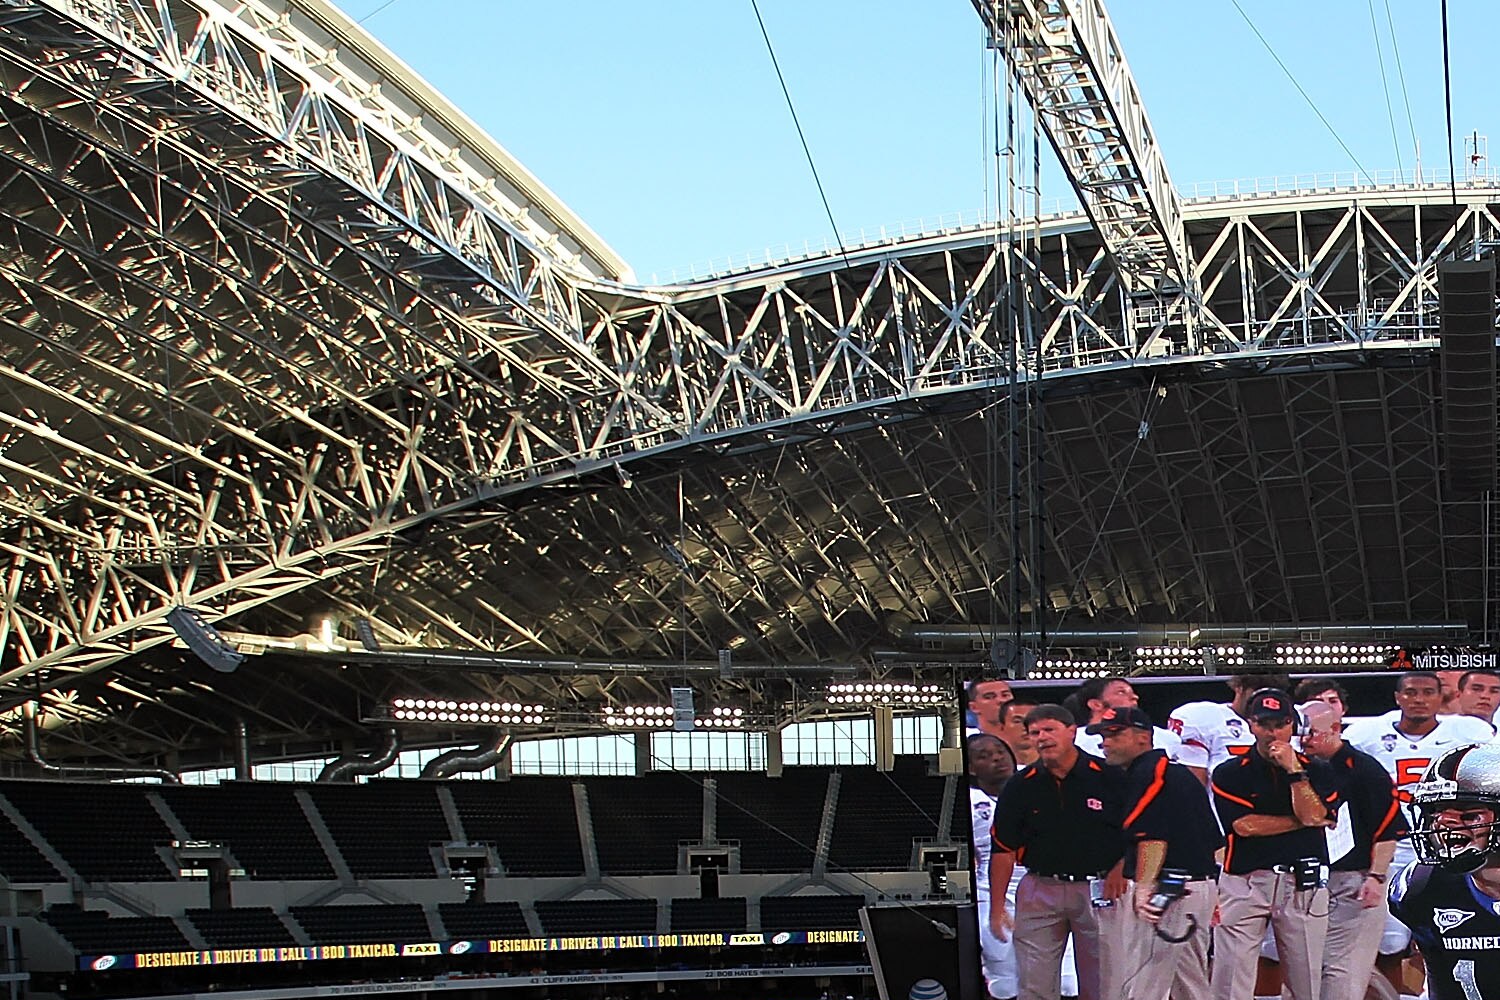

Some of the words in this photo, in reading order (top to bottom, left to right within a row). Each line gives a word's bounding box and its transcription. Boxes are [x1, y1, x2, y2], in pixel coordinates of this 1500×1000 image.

[1416, 654, 1496, 668] MITSUBISHI
[490, 939, 546, 952] DESIGNATE
[550, 938, 558, 950] A
[561, 937, 598, 950] DRIVER
[602, 937, 615, 949] OR
[620, 936, 644, 948] CALL
[648, 936, 654, 947] 1
[658, 935, 678, 946] 800
[681, 934, 726, 946] TAXICAB.
[808, 930, 859, 943] DESIGNATE
[138, 952, 199, 968] DESIGNATE
[204, 951, 211, 964] A
[215, 949, 257, 963] DRIVER
[262, 948, 276, 962] OR
[281, 947, 307, 961] CALL
[312, 946, 318, 959] 1
[323, 946, 345, 959] 800
[351, 944, 399, 958] TAXICAB.
